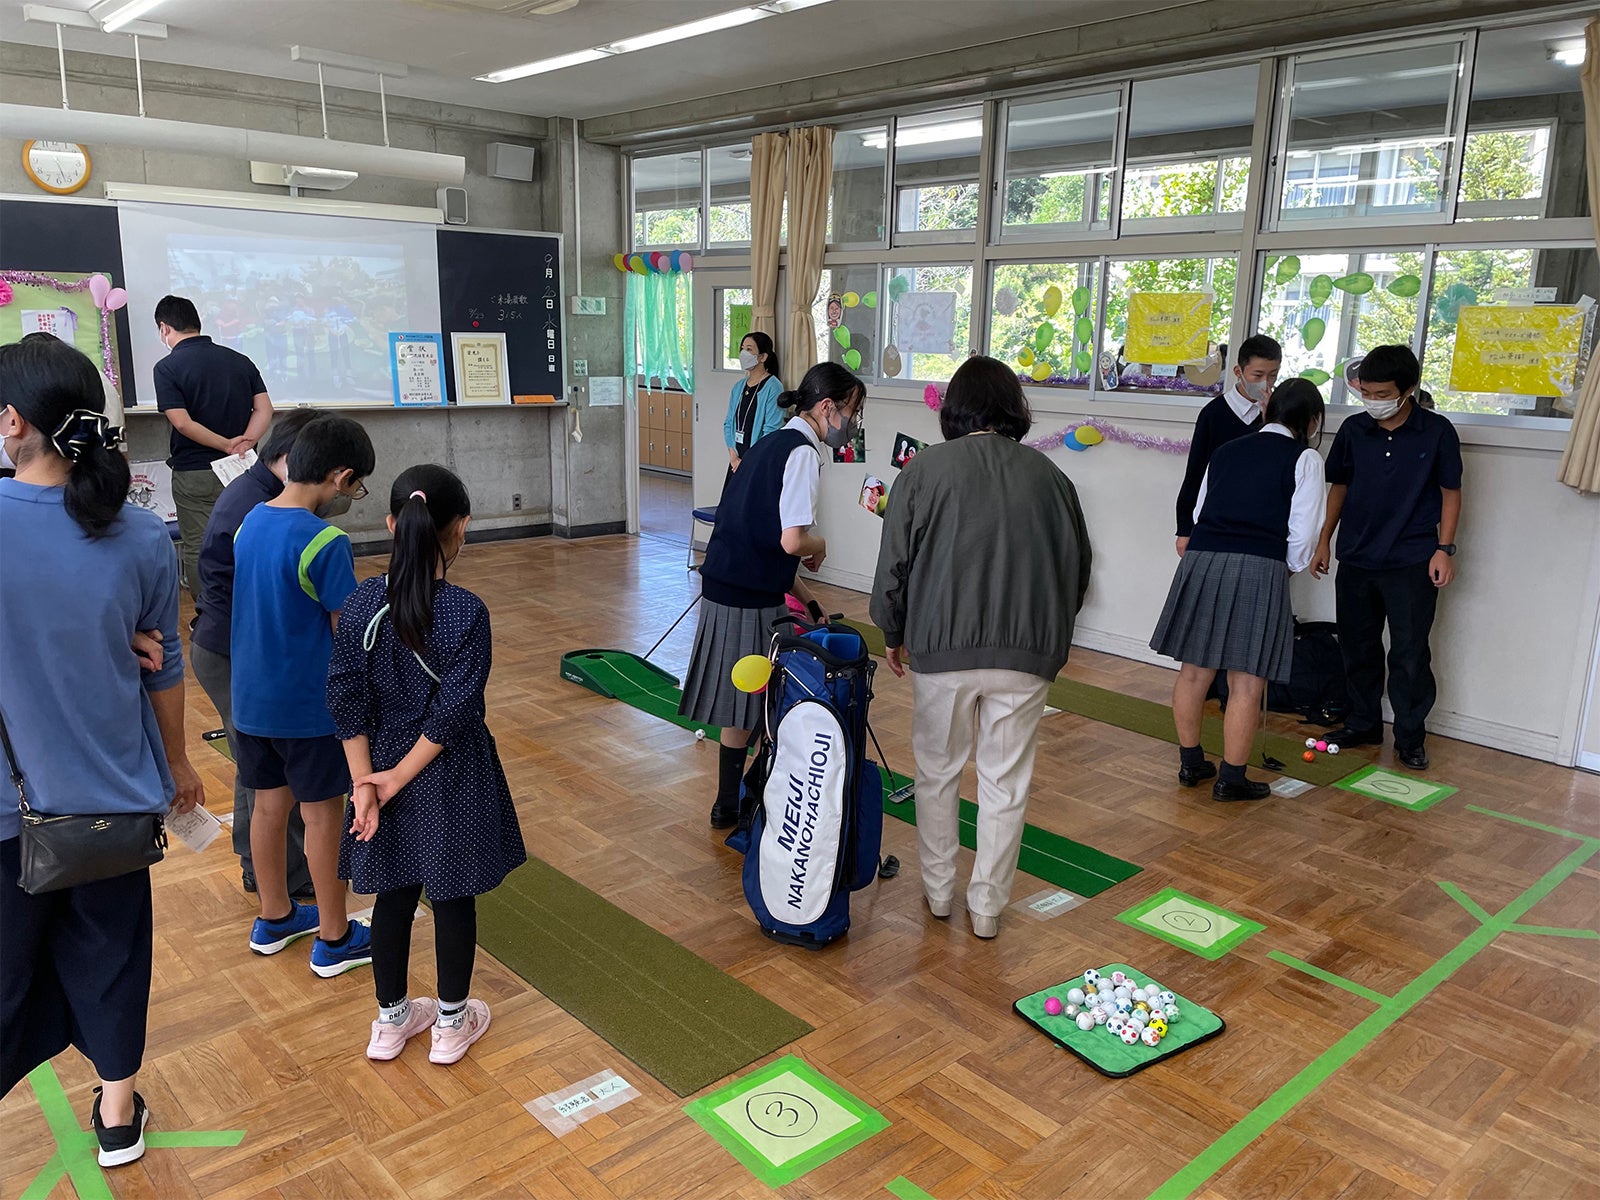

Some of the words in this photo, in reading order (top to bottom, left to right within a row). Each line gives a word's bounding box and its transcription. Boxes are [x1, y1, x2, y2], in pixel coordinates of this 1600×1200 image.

[56, 176, 62, 184] 6
[777, 774, 804, 852] MEIJI
[788, 733, 832, 909] NAKANOHACHIOJI
